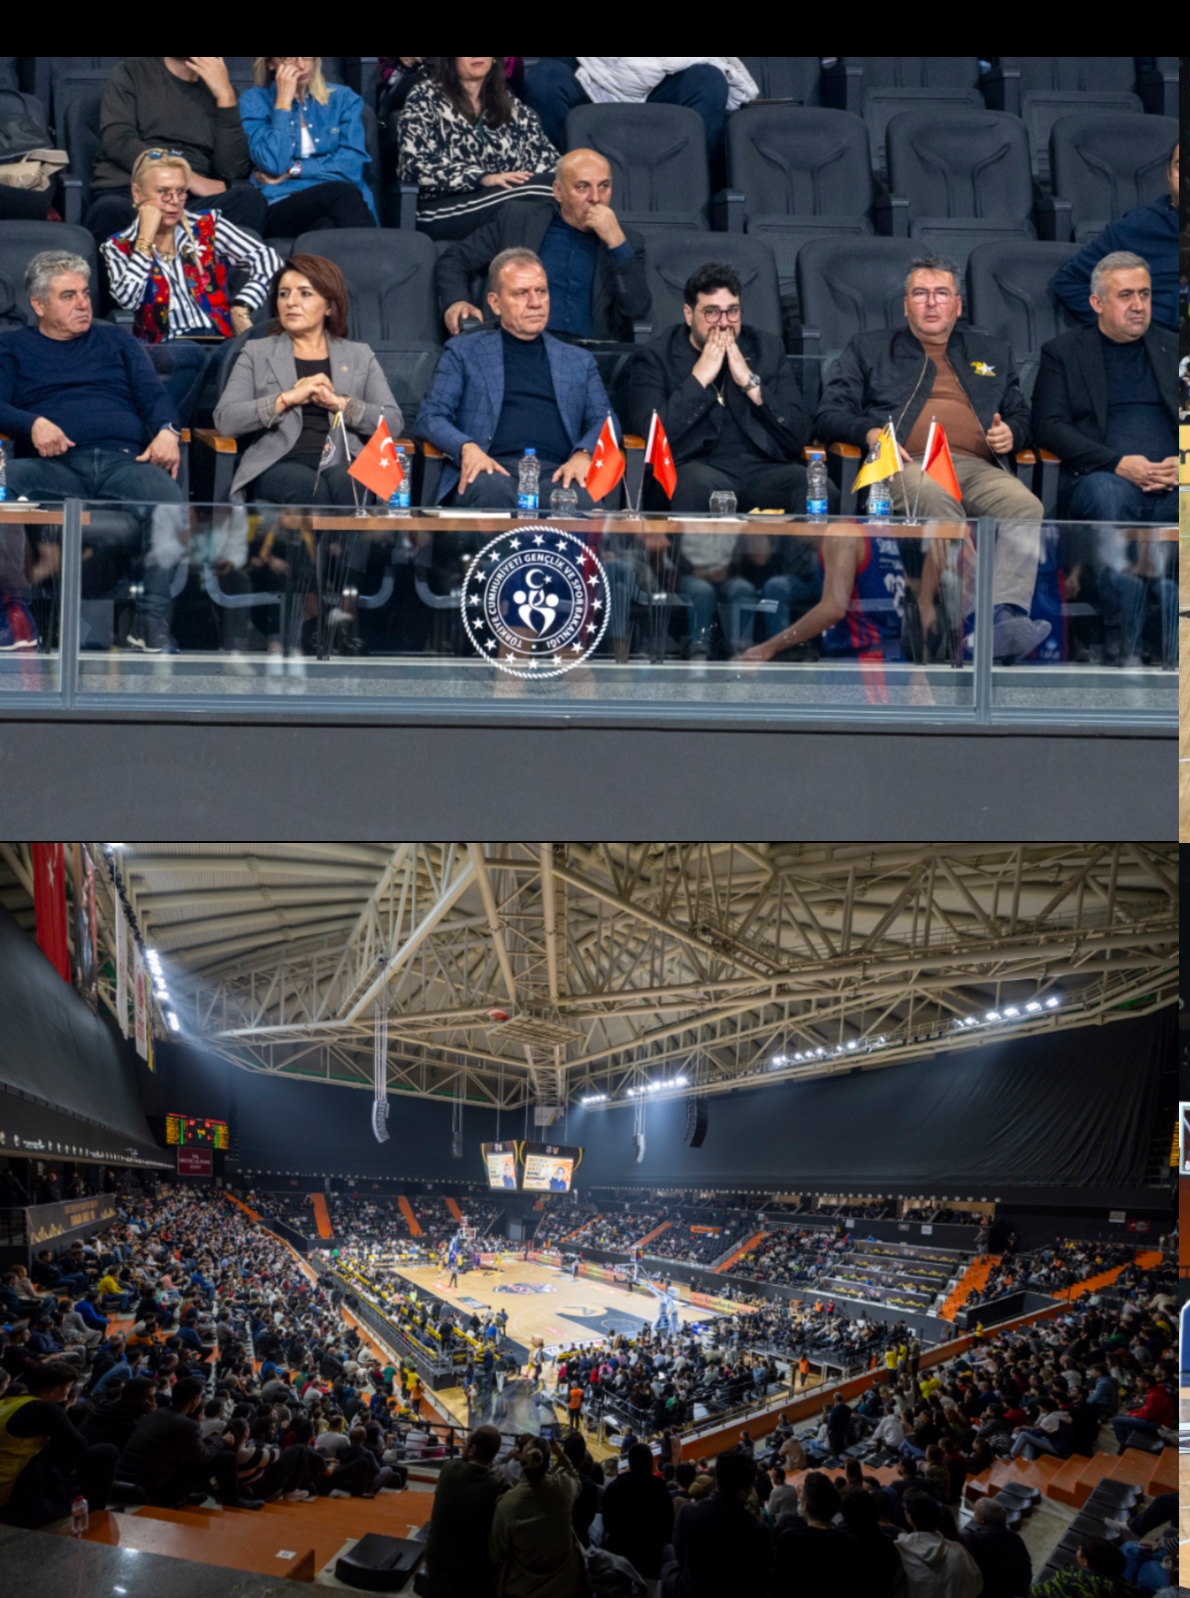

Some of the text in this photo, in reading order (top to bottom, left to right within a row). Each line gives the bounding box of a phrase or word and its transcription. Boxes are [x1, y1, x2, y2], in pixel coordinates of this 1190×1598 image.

[524, 555, 565, 570] GENÇLİK
[564, 564, 574, 578] VE
[571, 577, 584, 606] SPOR
[546, 605, 584, 649] BAKANLIĞI
